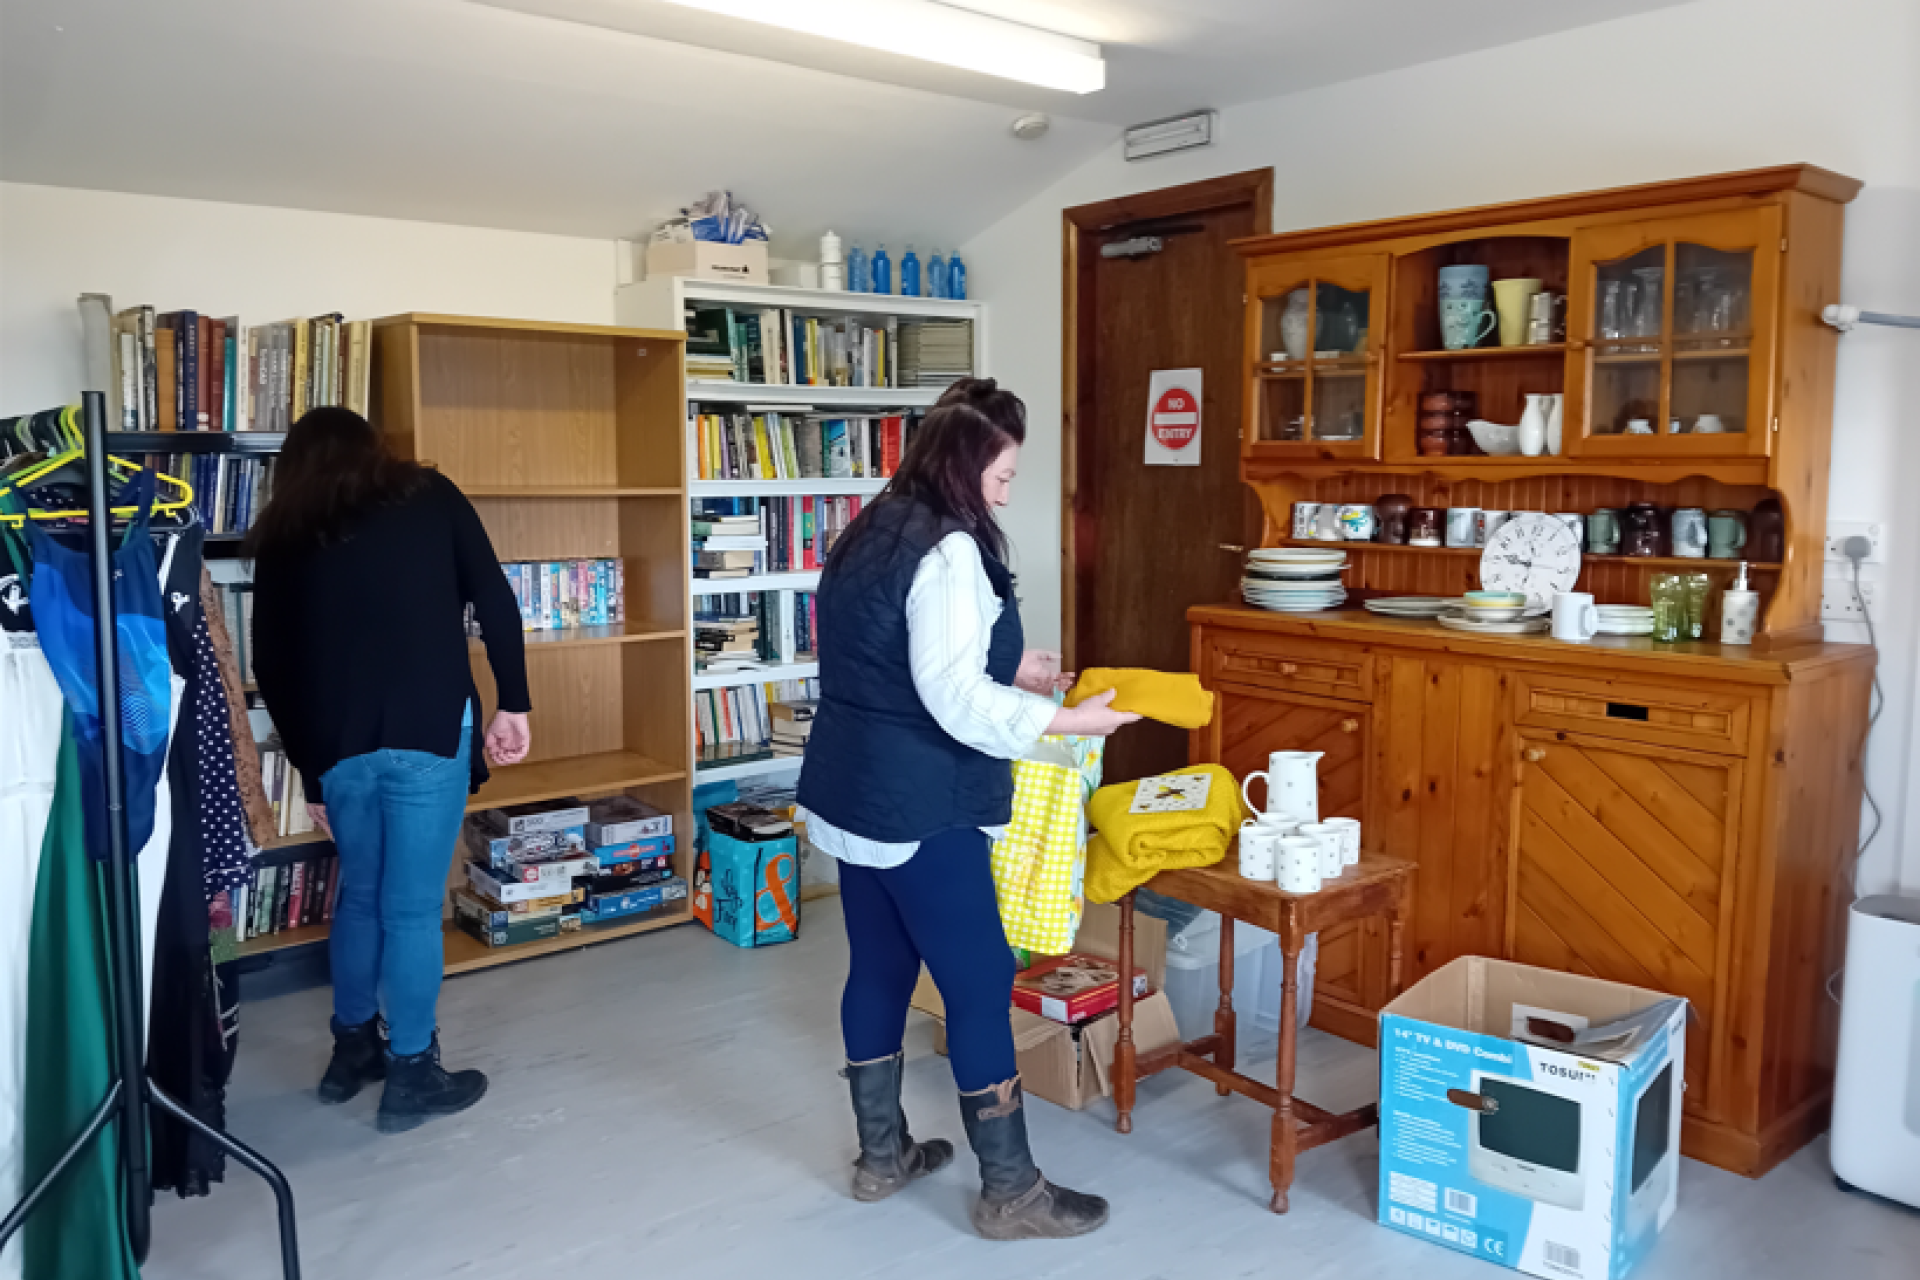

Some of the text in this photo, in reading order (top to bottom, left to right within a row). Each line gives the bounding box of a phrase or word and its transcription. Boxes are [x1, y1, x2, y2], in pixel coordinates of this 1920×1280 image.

[1167, 398, 1185, 410] NO
[1158, 428, 1192, 439] ENTRY
[1414, 1032, 1431, 1044] TV
[1444, 1039, 1471, 1054] DVD
